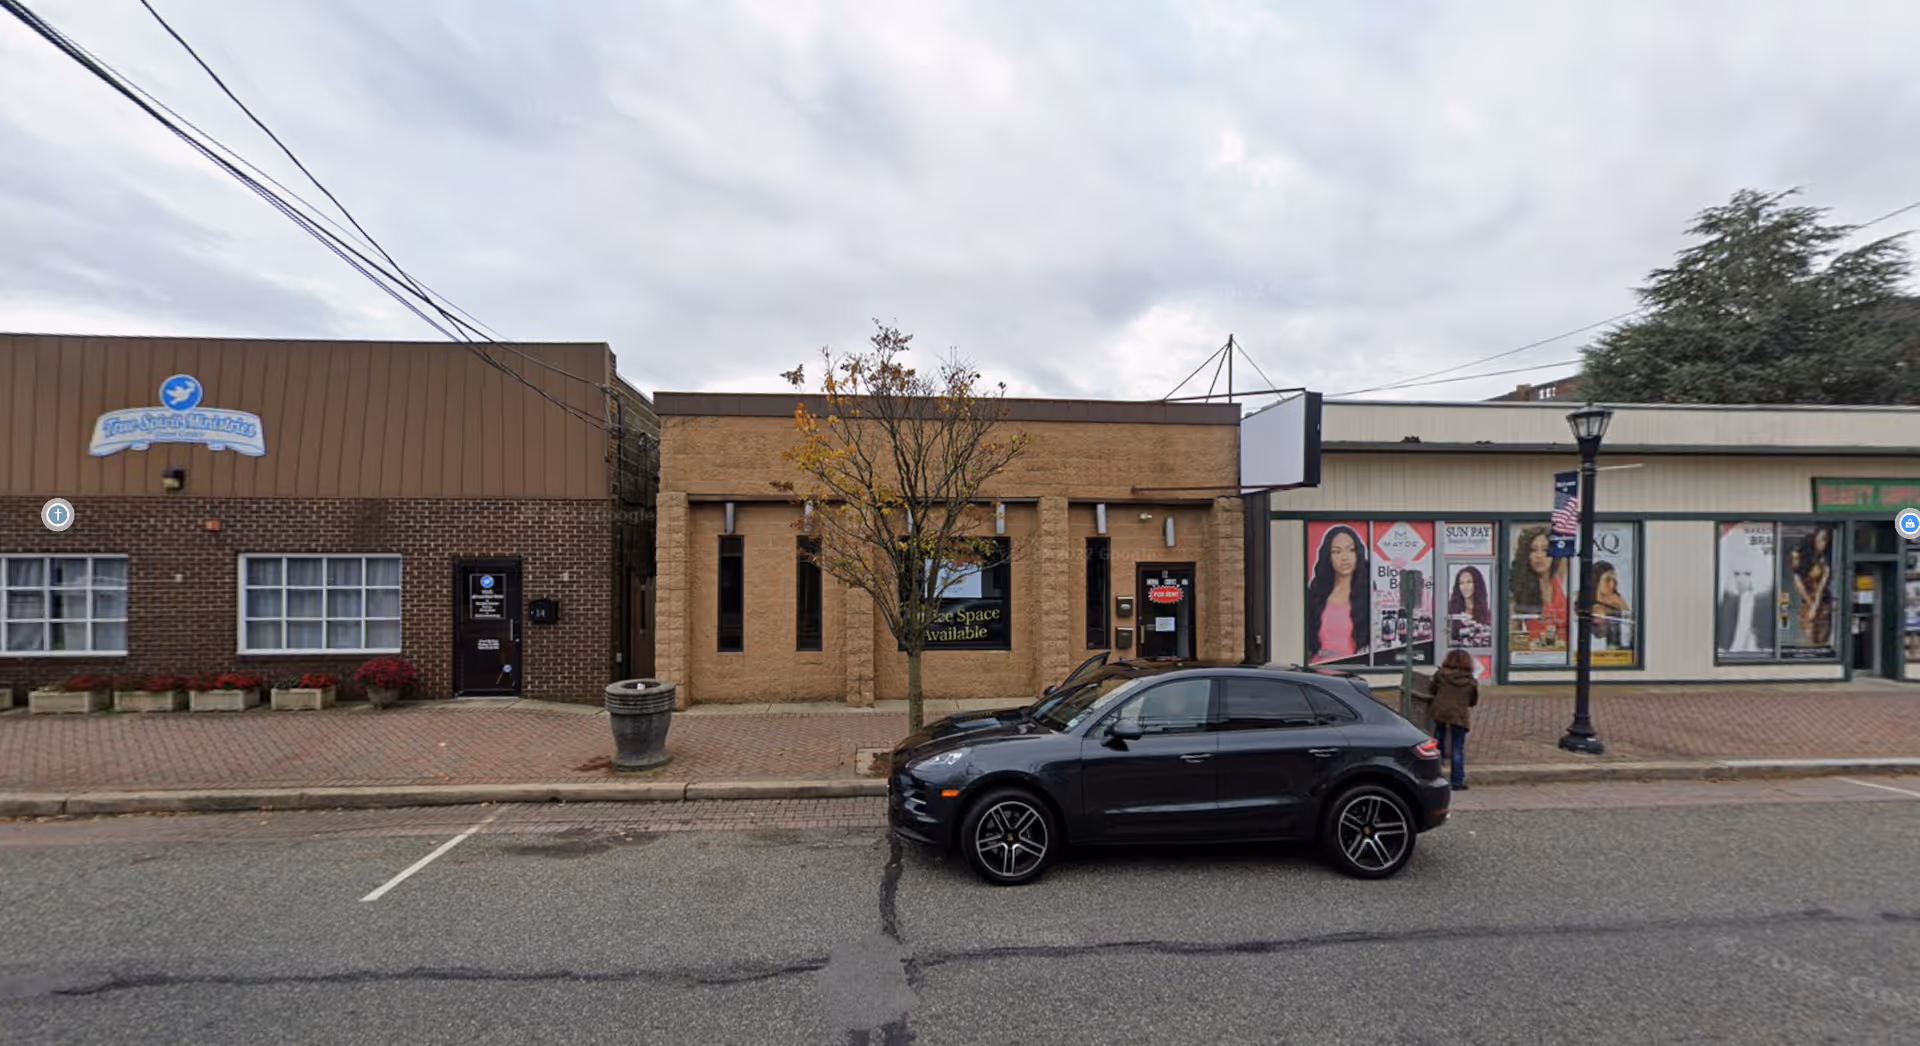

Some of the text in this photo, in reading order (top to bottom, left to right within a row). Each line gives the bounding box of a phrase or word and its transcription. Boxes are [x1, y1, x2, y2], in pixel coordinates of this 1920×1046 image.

[1446, 526, 1489, 538] SUN PAY
[956, 608, 1001, 625] Space
[924, 625, 988, 641] Available
